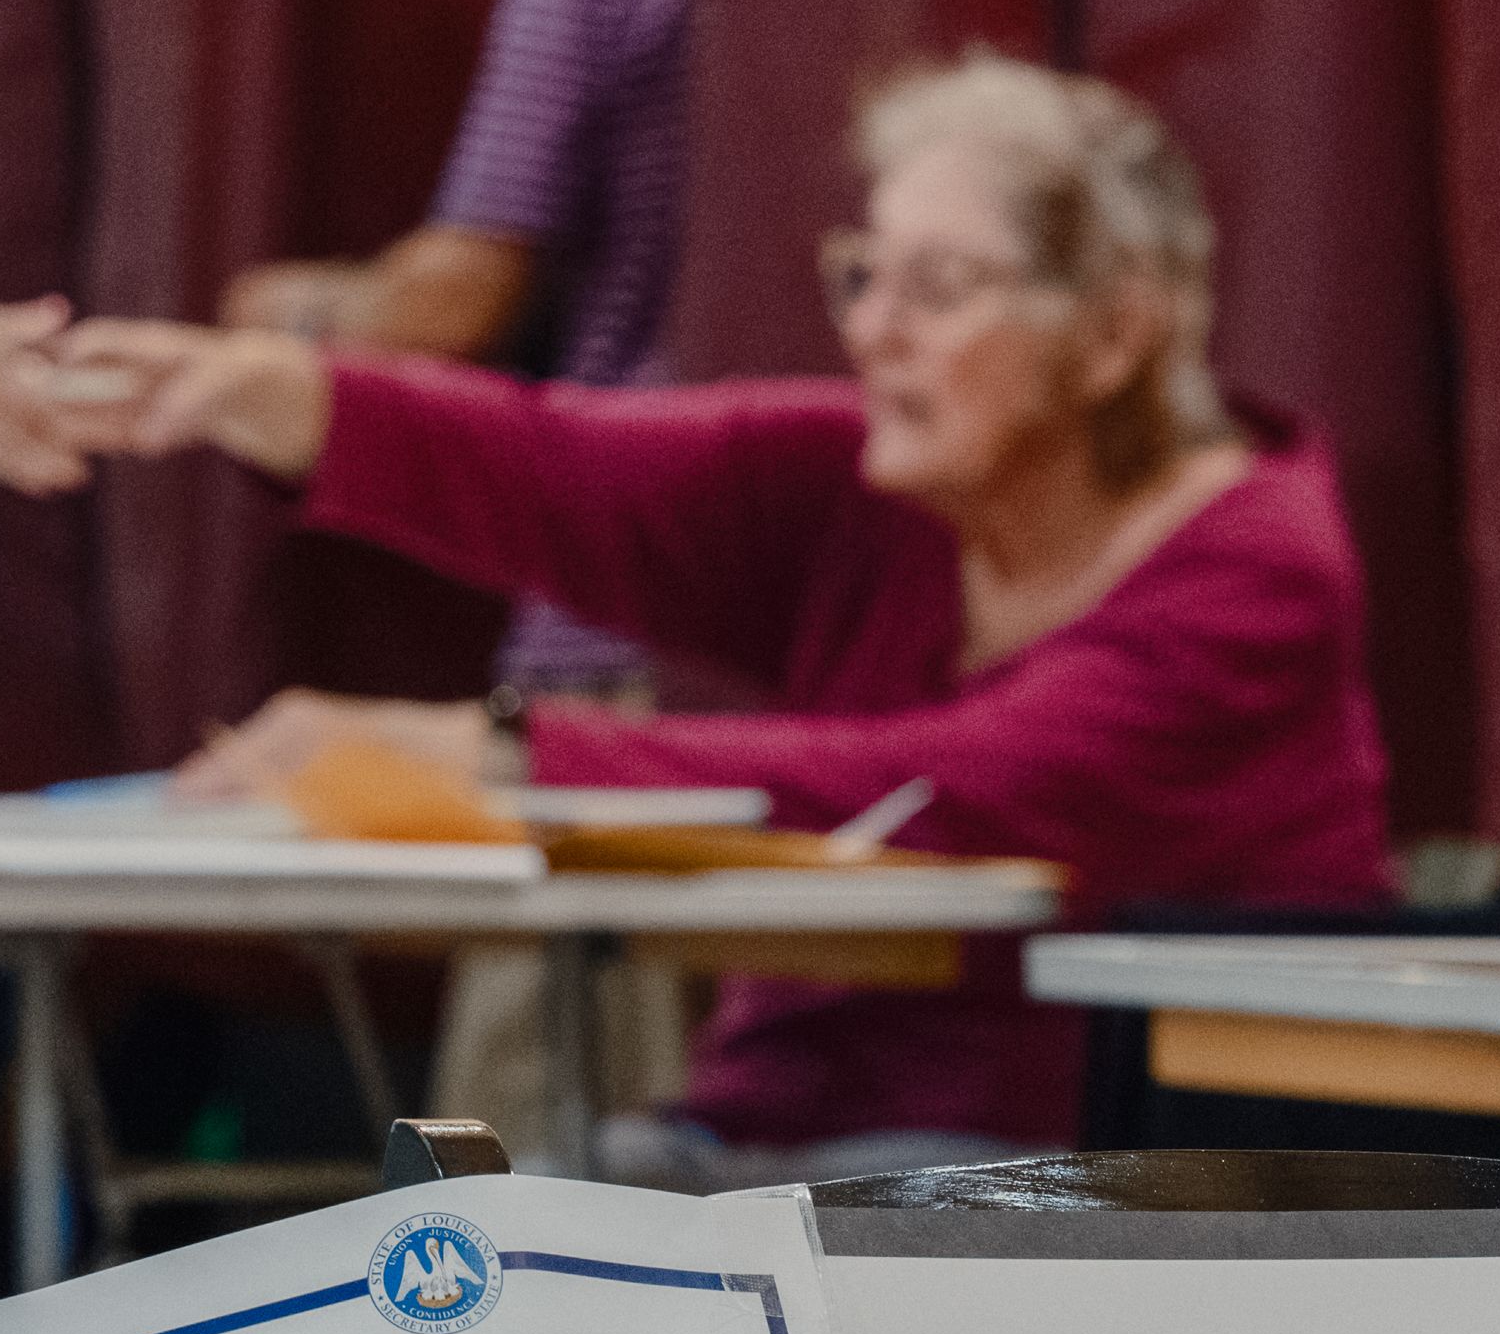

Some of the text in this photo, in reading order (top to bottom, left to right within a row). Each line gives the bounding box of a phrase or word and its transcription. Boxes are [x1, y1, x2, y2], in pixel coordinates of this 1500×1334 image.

[372, 1215, 496, 1286] STATE OF LOUISIANA
[388, 1237, 413, 1266] UNION
[428, 1228, 473, 1249] JUSTICE
[381, 1284, 500, 1334] SECRETARY OF STATE
[409, 1298, 475, 1320] CONFIDENCE
